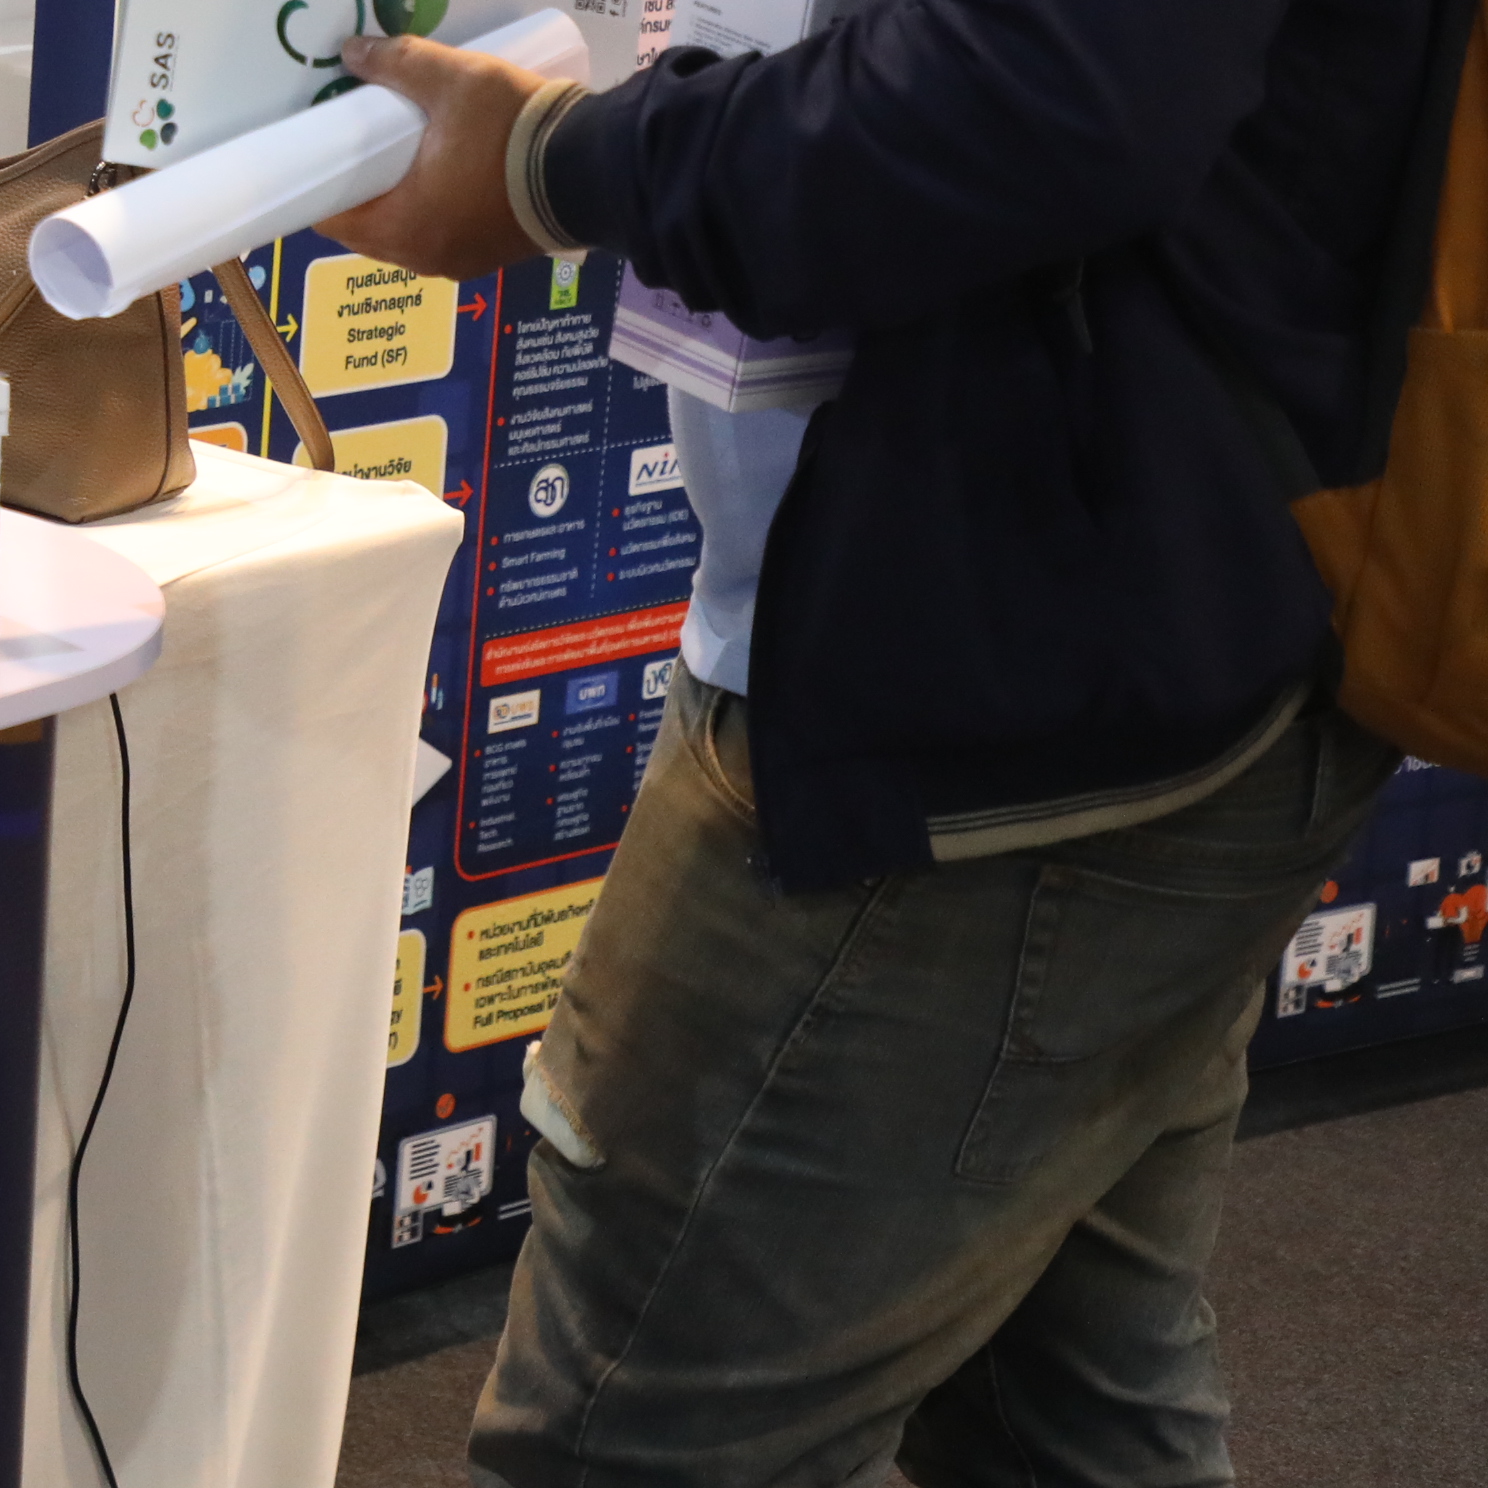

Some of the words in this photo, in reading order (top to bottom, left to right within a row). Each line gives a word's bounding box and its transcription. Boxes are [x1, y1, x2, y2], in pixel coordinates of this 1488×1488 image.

[149, 31, 177, 91] SAS
[337, 288, 423, 319] งานเชิงกลยุทธ์
[346, 321, 407, 344] Strategic
[344, 350, 379, 371] Fund
[380, 345, 409, 370] (SF)
[473, 1010, 495, 1030] Full
[495, 999, 545, 1022] Proposal
